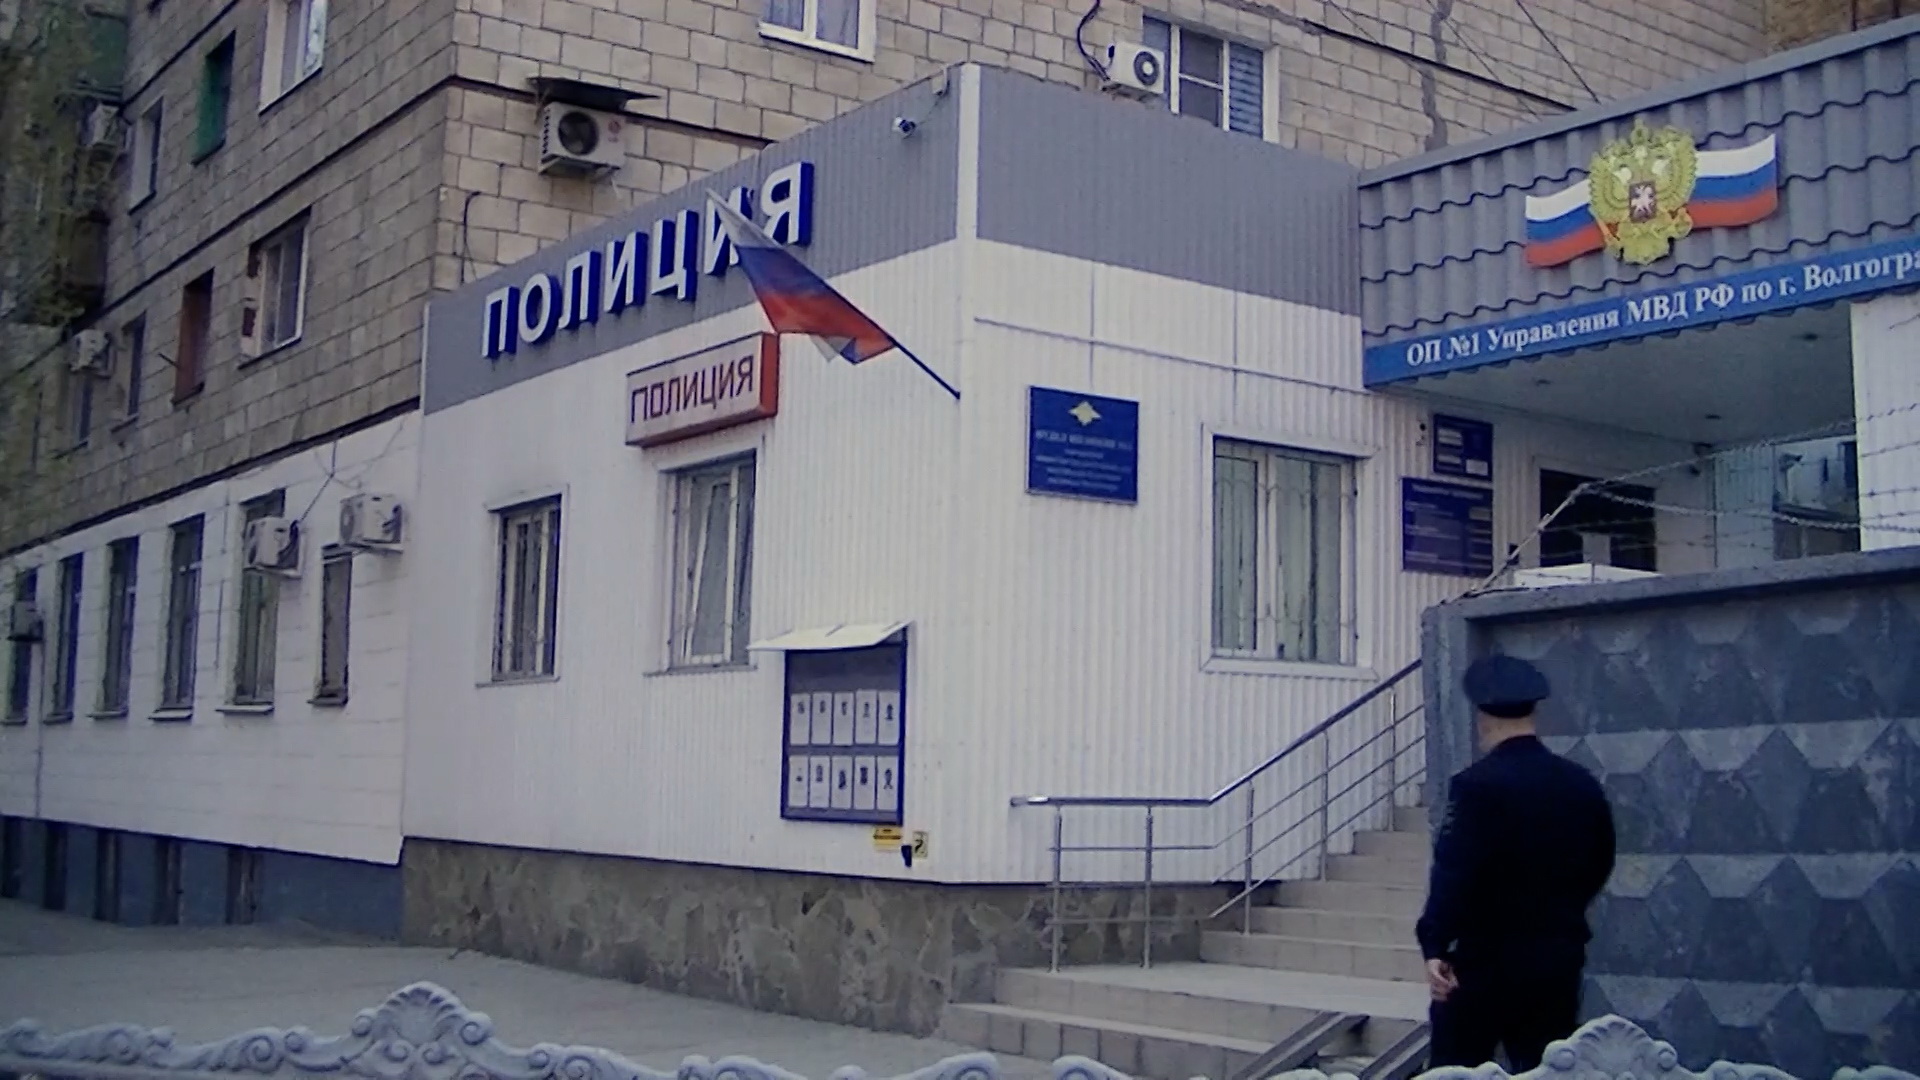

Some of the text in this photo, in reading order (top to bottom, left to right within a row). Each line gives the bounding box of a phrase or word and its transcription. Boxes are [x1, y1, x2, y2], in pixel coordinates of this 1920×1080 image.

[482, 162, 813, 358] ПОЛИЦИЯ
[1406, 339, 1441, 366] ОП
[1446, 337, 1480, 360] №1
[1487, 309, 1619, 352] Управления
[1626, 290, 1689, 324] МВД
[1694, 283, 1735, 313] РФ
[1741, 280, 1772, 303] по
[1778, 277, 1797, 296] г.
[631, 354, 754, 423] ПОЛИЦИЯ
